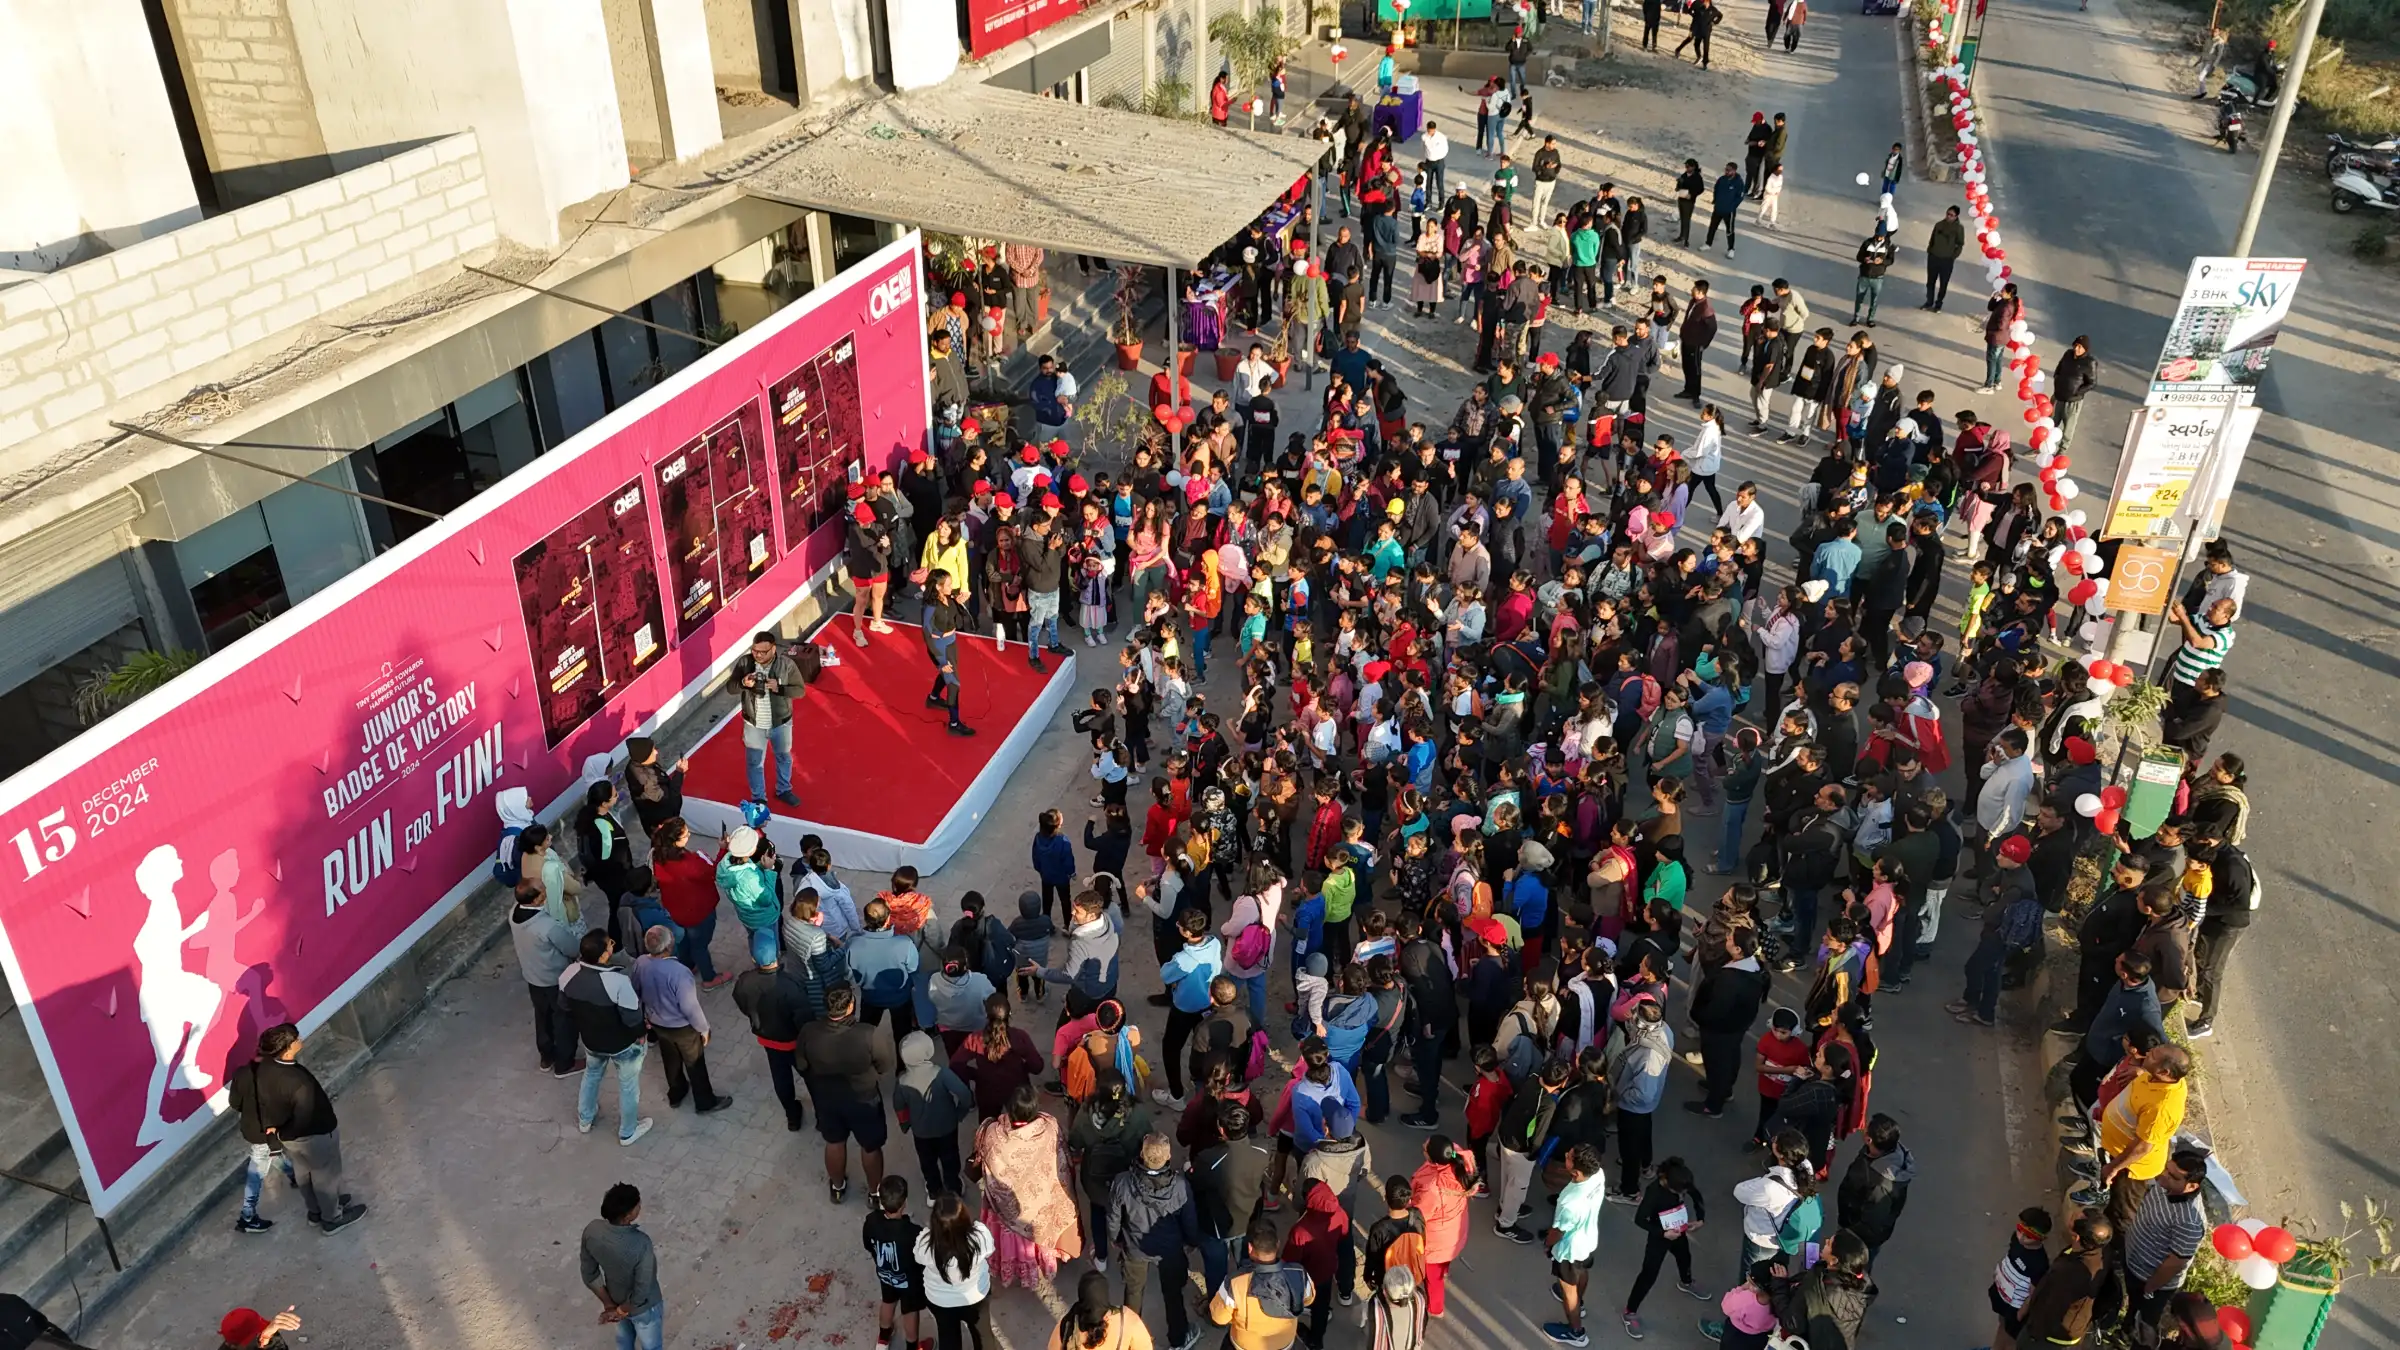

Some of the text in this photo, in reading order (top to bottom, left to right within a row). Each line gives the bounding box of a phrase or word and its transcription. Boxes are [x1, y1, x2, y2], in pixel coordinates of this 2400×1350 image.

[2190, 289, 2229, 300] 3 BHK
[355, 658, 424, 711] TINY STRIDES TOWARDS
[369, 674, 417, 711] HAPPIER FUTURE
[361, 676, 437, 754] JUNIOR'S
[323, 680, 477, 819] BADGE OF VICTORY
[401, 759, 420, 780] 2024
[81, 757, 160, 814] DECEMBER
[86, 783, 149, 839] 2024
[8, 805, 77, 883] 15
[323, 721, 504, 918] RUN FOR FUN!
